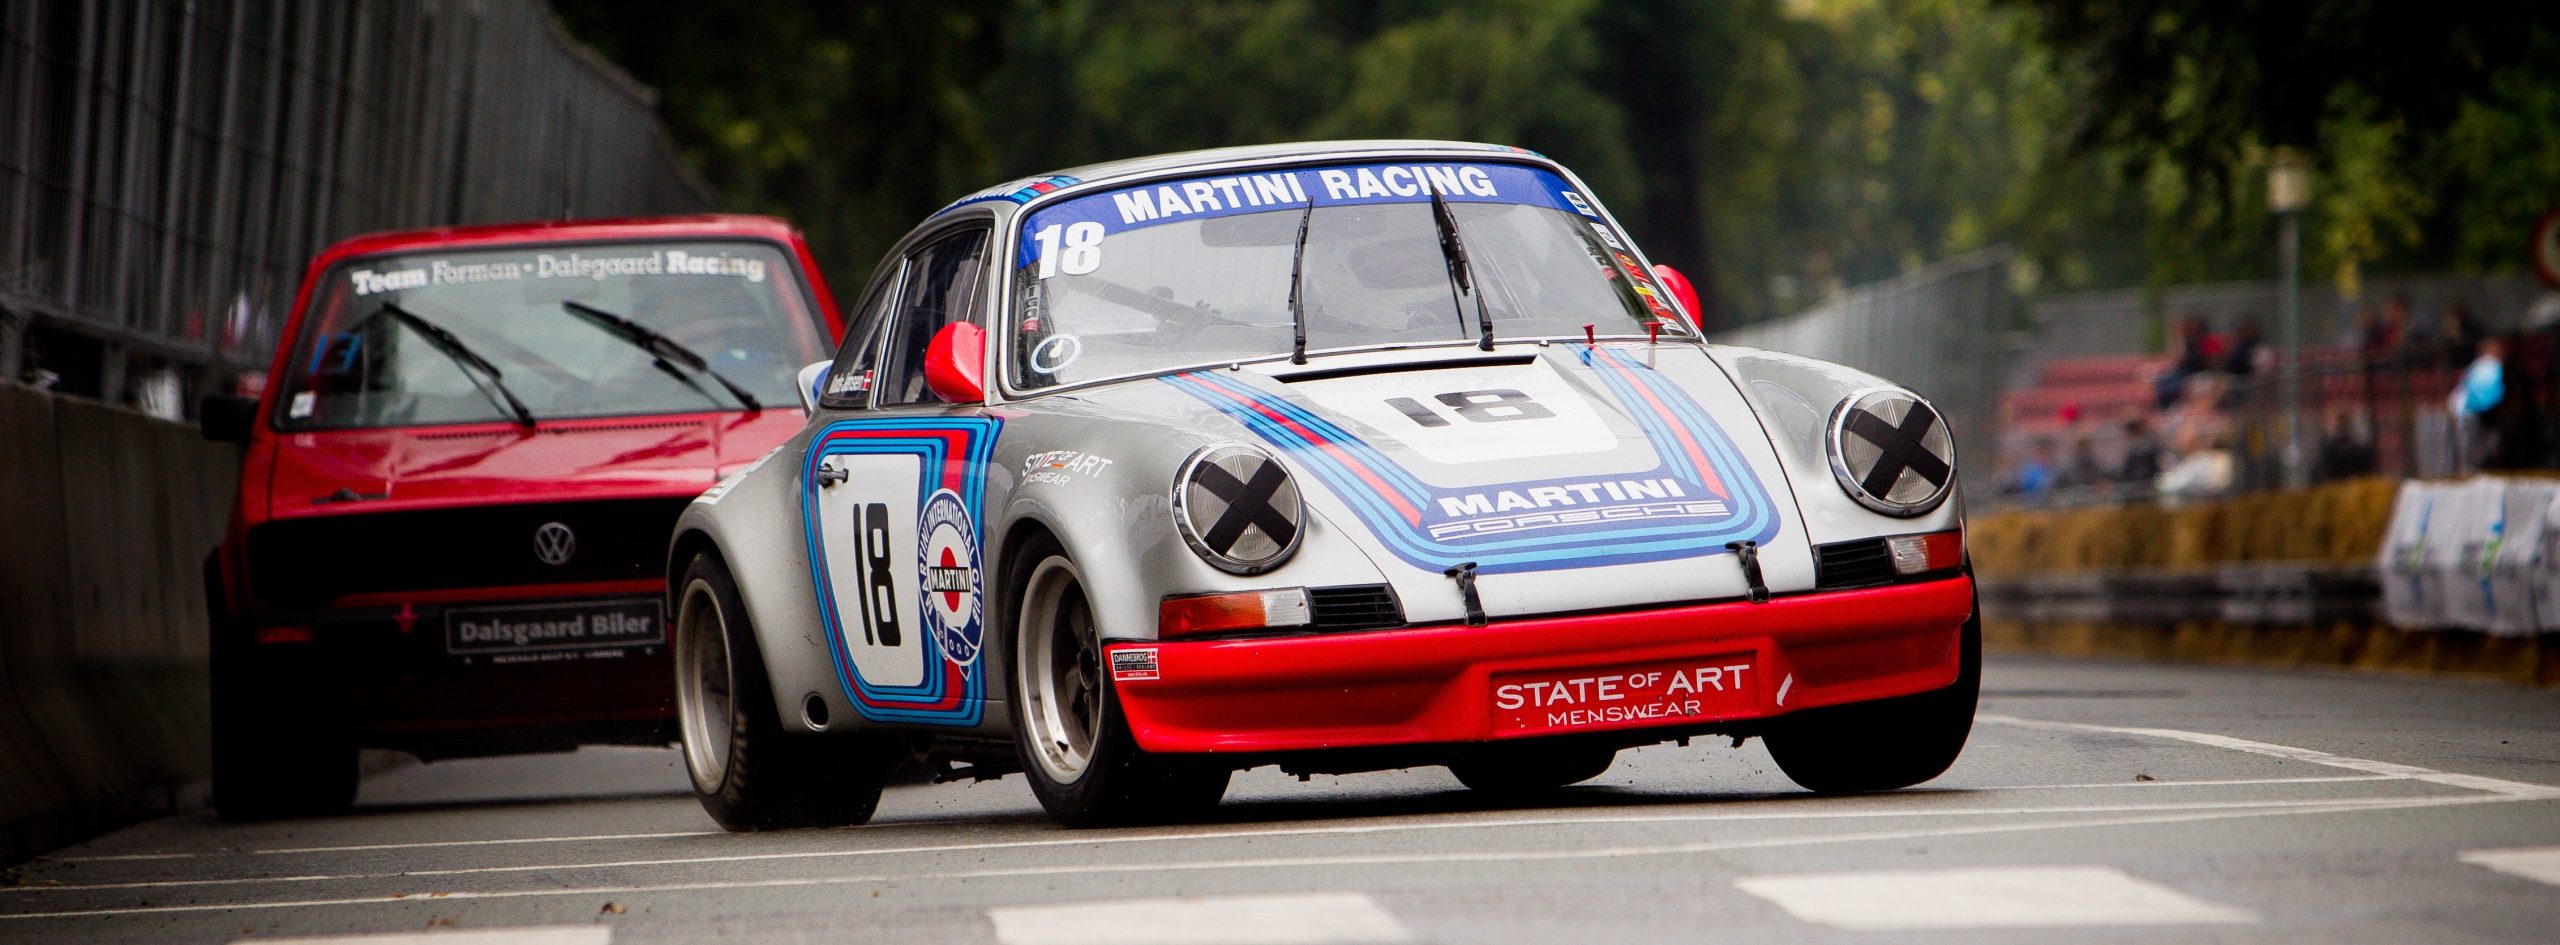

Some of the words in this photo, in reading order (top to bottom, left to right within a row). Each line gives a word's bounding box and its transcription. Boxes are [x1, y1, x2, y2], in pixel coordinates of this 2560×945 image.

[1112, 173, 1308, 225] MARTINI
[1318, 166, 1498, 200] RACING
[1034, 221, 1105, 281] 18
[352, 267, 427, 295] Team
[431, 259, 521, 285] Forman
[537, 251, 663, 280] Dalsgaard
[666, 251, 766, 283] Racing
[1384, 388, 1557, 428] 18
[1064, 452, 1114, 478] ART
[1437, 478, 1686, 518] MARTINI
[1430, 502, 1730, 540] PORSCHE
[853, 502, 902, 647] 18
[926, 499, 975, 562] INTERNATIONAL
[972, 567, 982, 627] CLUB
[930, 568, 971, 591] MARTINI
[460, 615, 585, 646] Dalsgaard
[592, 612, 652, 635] Biler
[1114, 652, 1148, 662] DANNEBROG
[1496, 675, 1625, 710] STATE
[1628, 671, 1662, 689] OF
[1666, 664, 1750, 696] ART
[1548, 699, 1702, 728] MENSWEAR
